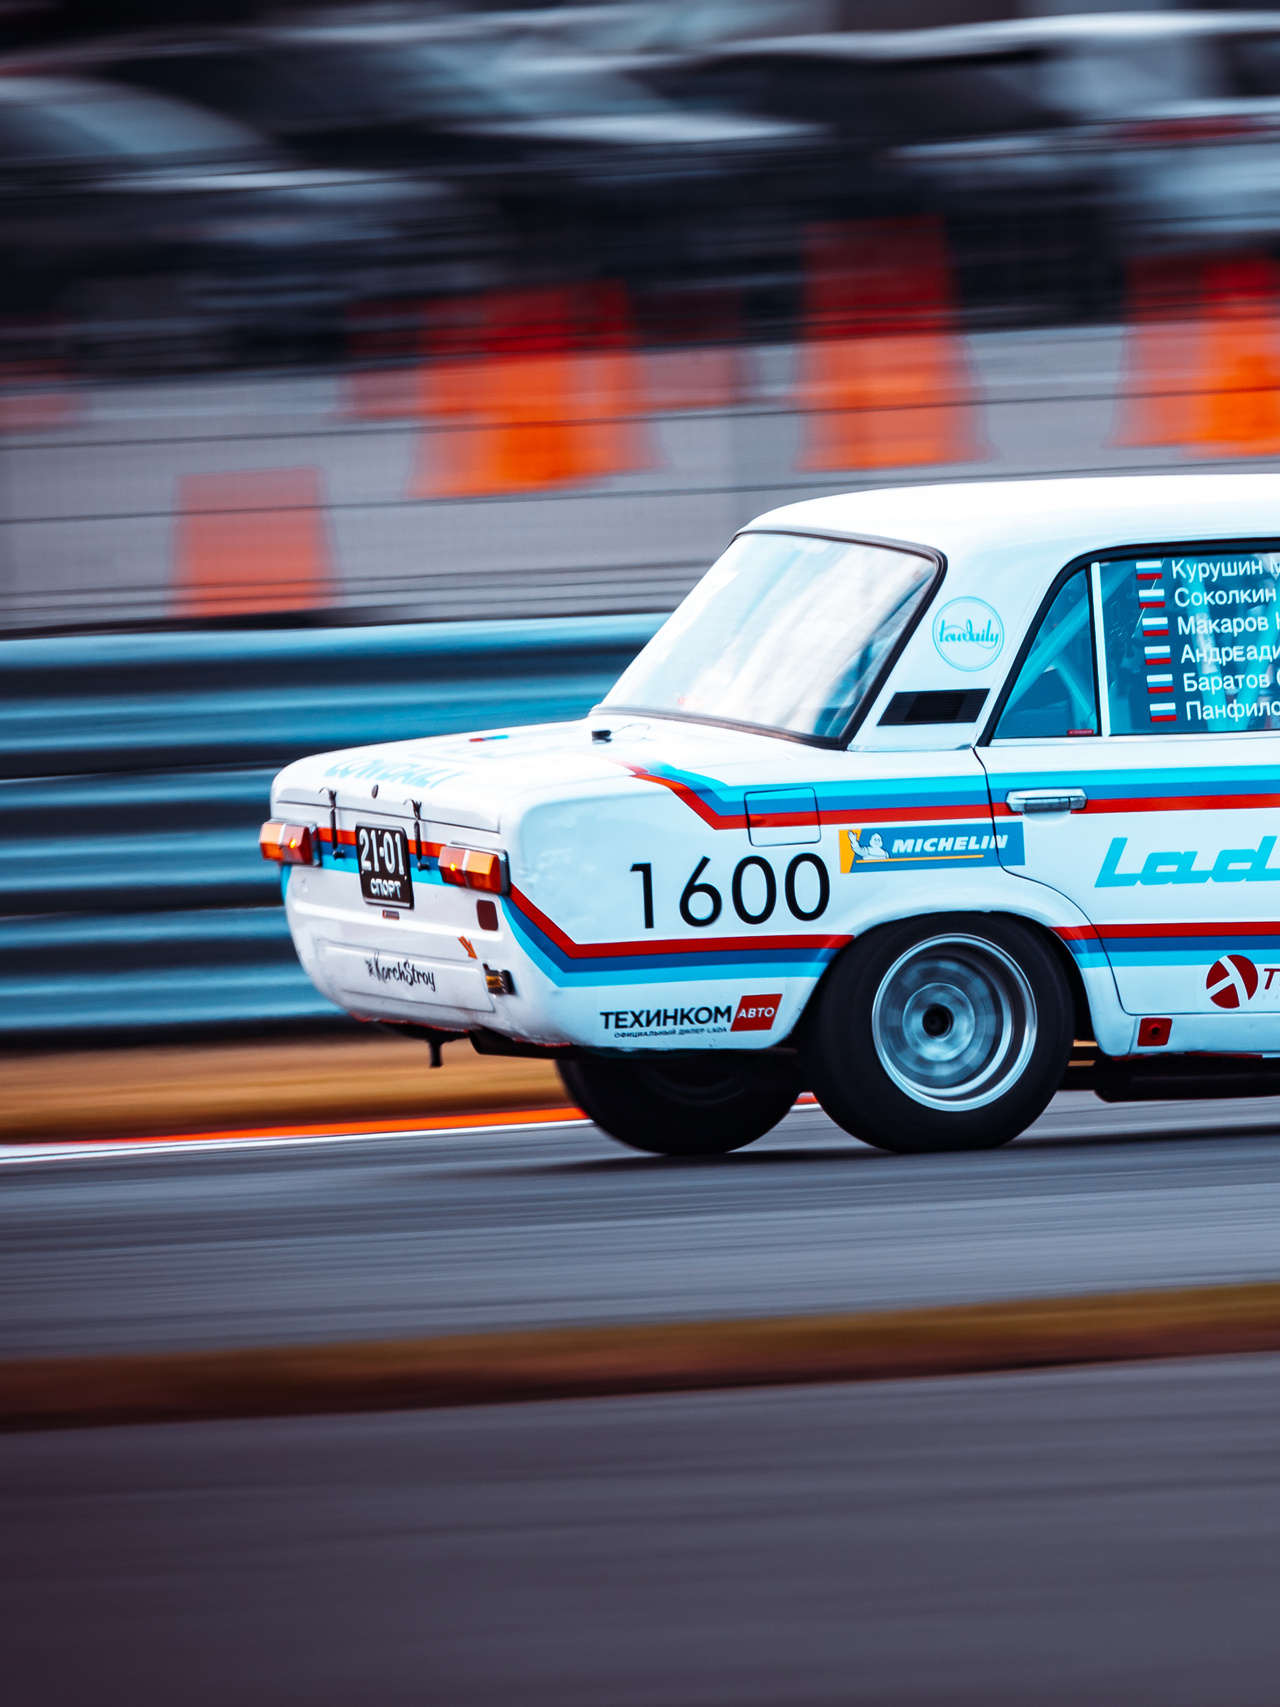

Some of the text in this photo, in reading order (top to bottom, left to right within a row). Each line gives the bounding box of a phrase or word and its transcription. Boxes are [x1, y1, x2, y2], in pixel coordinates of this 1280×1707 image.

[1171, 559, 1264, 582] Курушин
[1174, 587, 1277, 607] Соколкин
[1177, 614, 1270, 636] Макаров
[1183, 670, 1271, 694] Баратов
[891, 834, 1009, 855] MICHELIN
[629, 852, 831, 929] 1600
[600, 1005, 775, 1030] ТЕХИНКОМ АВТО
